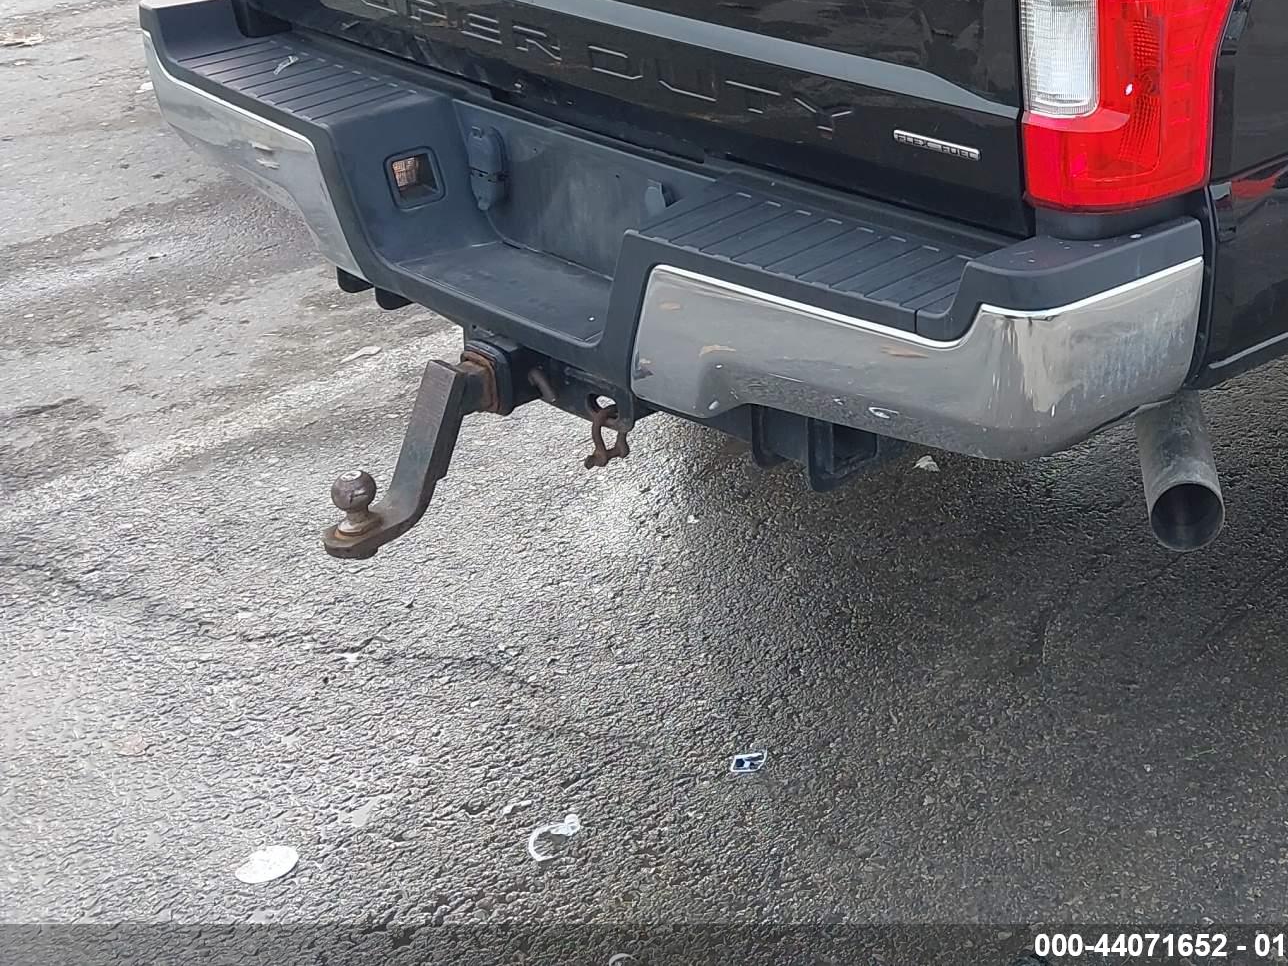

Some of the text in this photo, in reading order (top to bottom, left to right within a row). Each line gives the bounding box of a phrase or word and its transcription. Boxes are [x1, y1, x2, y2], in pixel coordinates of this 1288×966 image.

[588, 39, 853, 132] DUTY
[897, 133, 978, 161] FLEX FUEL
